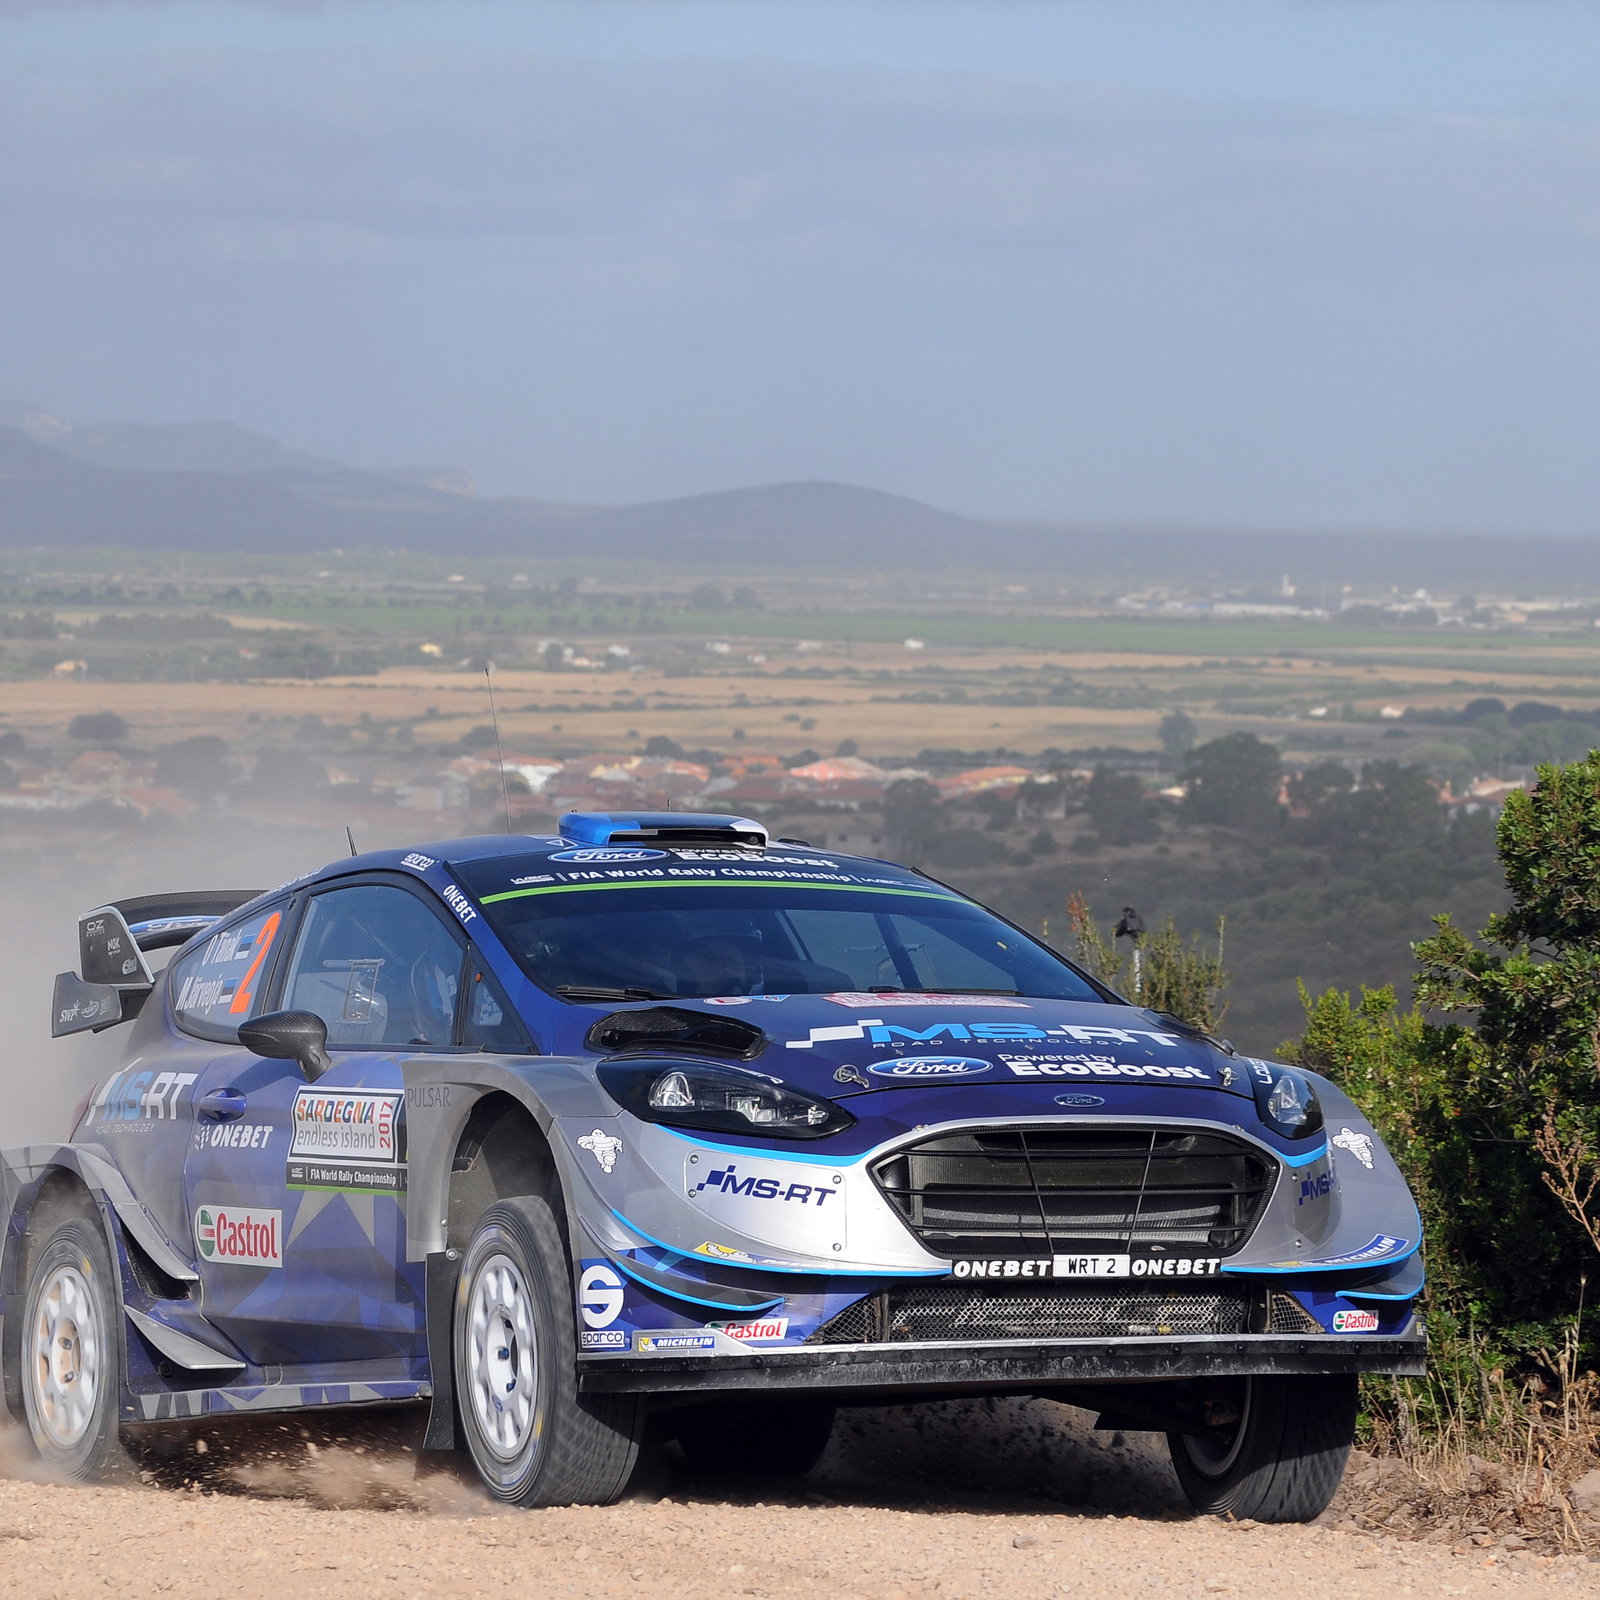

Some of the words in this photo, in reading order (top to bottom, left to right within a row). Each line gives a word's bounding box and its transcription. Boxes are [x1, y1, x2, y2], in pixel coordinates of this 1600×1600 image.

[573, 847, 647, 861] Ford
[676, 851, 839, 868] EcoBoost
[568, 871, 604, 880] FIA
[605, 868, 664, 878] World
[668, 867, 717, 877] Rally
[720, 868, 852, 882] Championship
[443, 884, 477, 923] ONEBET
[86, 919, 104, 931] OZ
[229, 912, 281, 1014] 2
[869, 1022, 1181, 1047] MS-RT
[873, 1039, 943, 1048] ROAD
[960, 1038, 1126, 1047] TECHNOLOGY
[892, 1059, 970, 1074] Ford
[997, 1053, 1088, 1063] Powered
[1090, 1053, 1116, 1064] by
[1006, 1060, 1212, 1080] EcoBoost
[101, 1071, 199, 1122] MS-RT
[297, 1098, 375, 1124] SARDEGNA
[379, 1101, 394, 1149] 2017
[211, 1124, 274, 1149] ONEBET
[297, 1124, 338, 1148] endless
[341, 1126, 376, 1149] island
[310, 1169, 320, 1180] FIA
[321, 1169, 337, 1181] World
[338, 1170, 353, 1184] Rally
[354, 1171, 397, 1187] Championship
[720, 1173, 837, 1206] MS-RT
[216, 1212, 278, 1259] Castrol
[953, 1260, 1052, 1277] ONEBET
[1068, 1258, 1098, 1273] WRT
[1106, 1258, 1116, 1273] 2
[1131, 1258, 1221, 1276] ONEBET
[1345, 1312, 1377, 1329] Castrol
[582, 1331, 623, 1345] sparco
[724, 1322, 782, 1338] Castrol
[657, 1336, 714, 1347] MICHELIN
